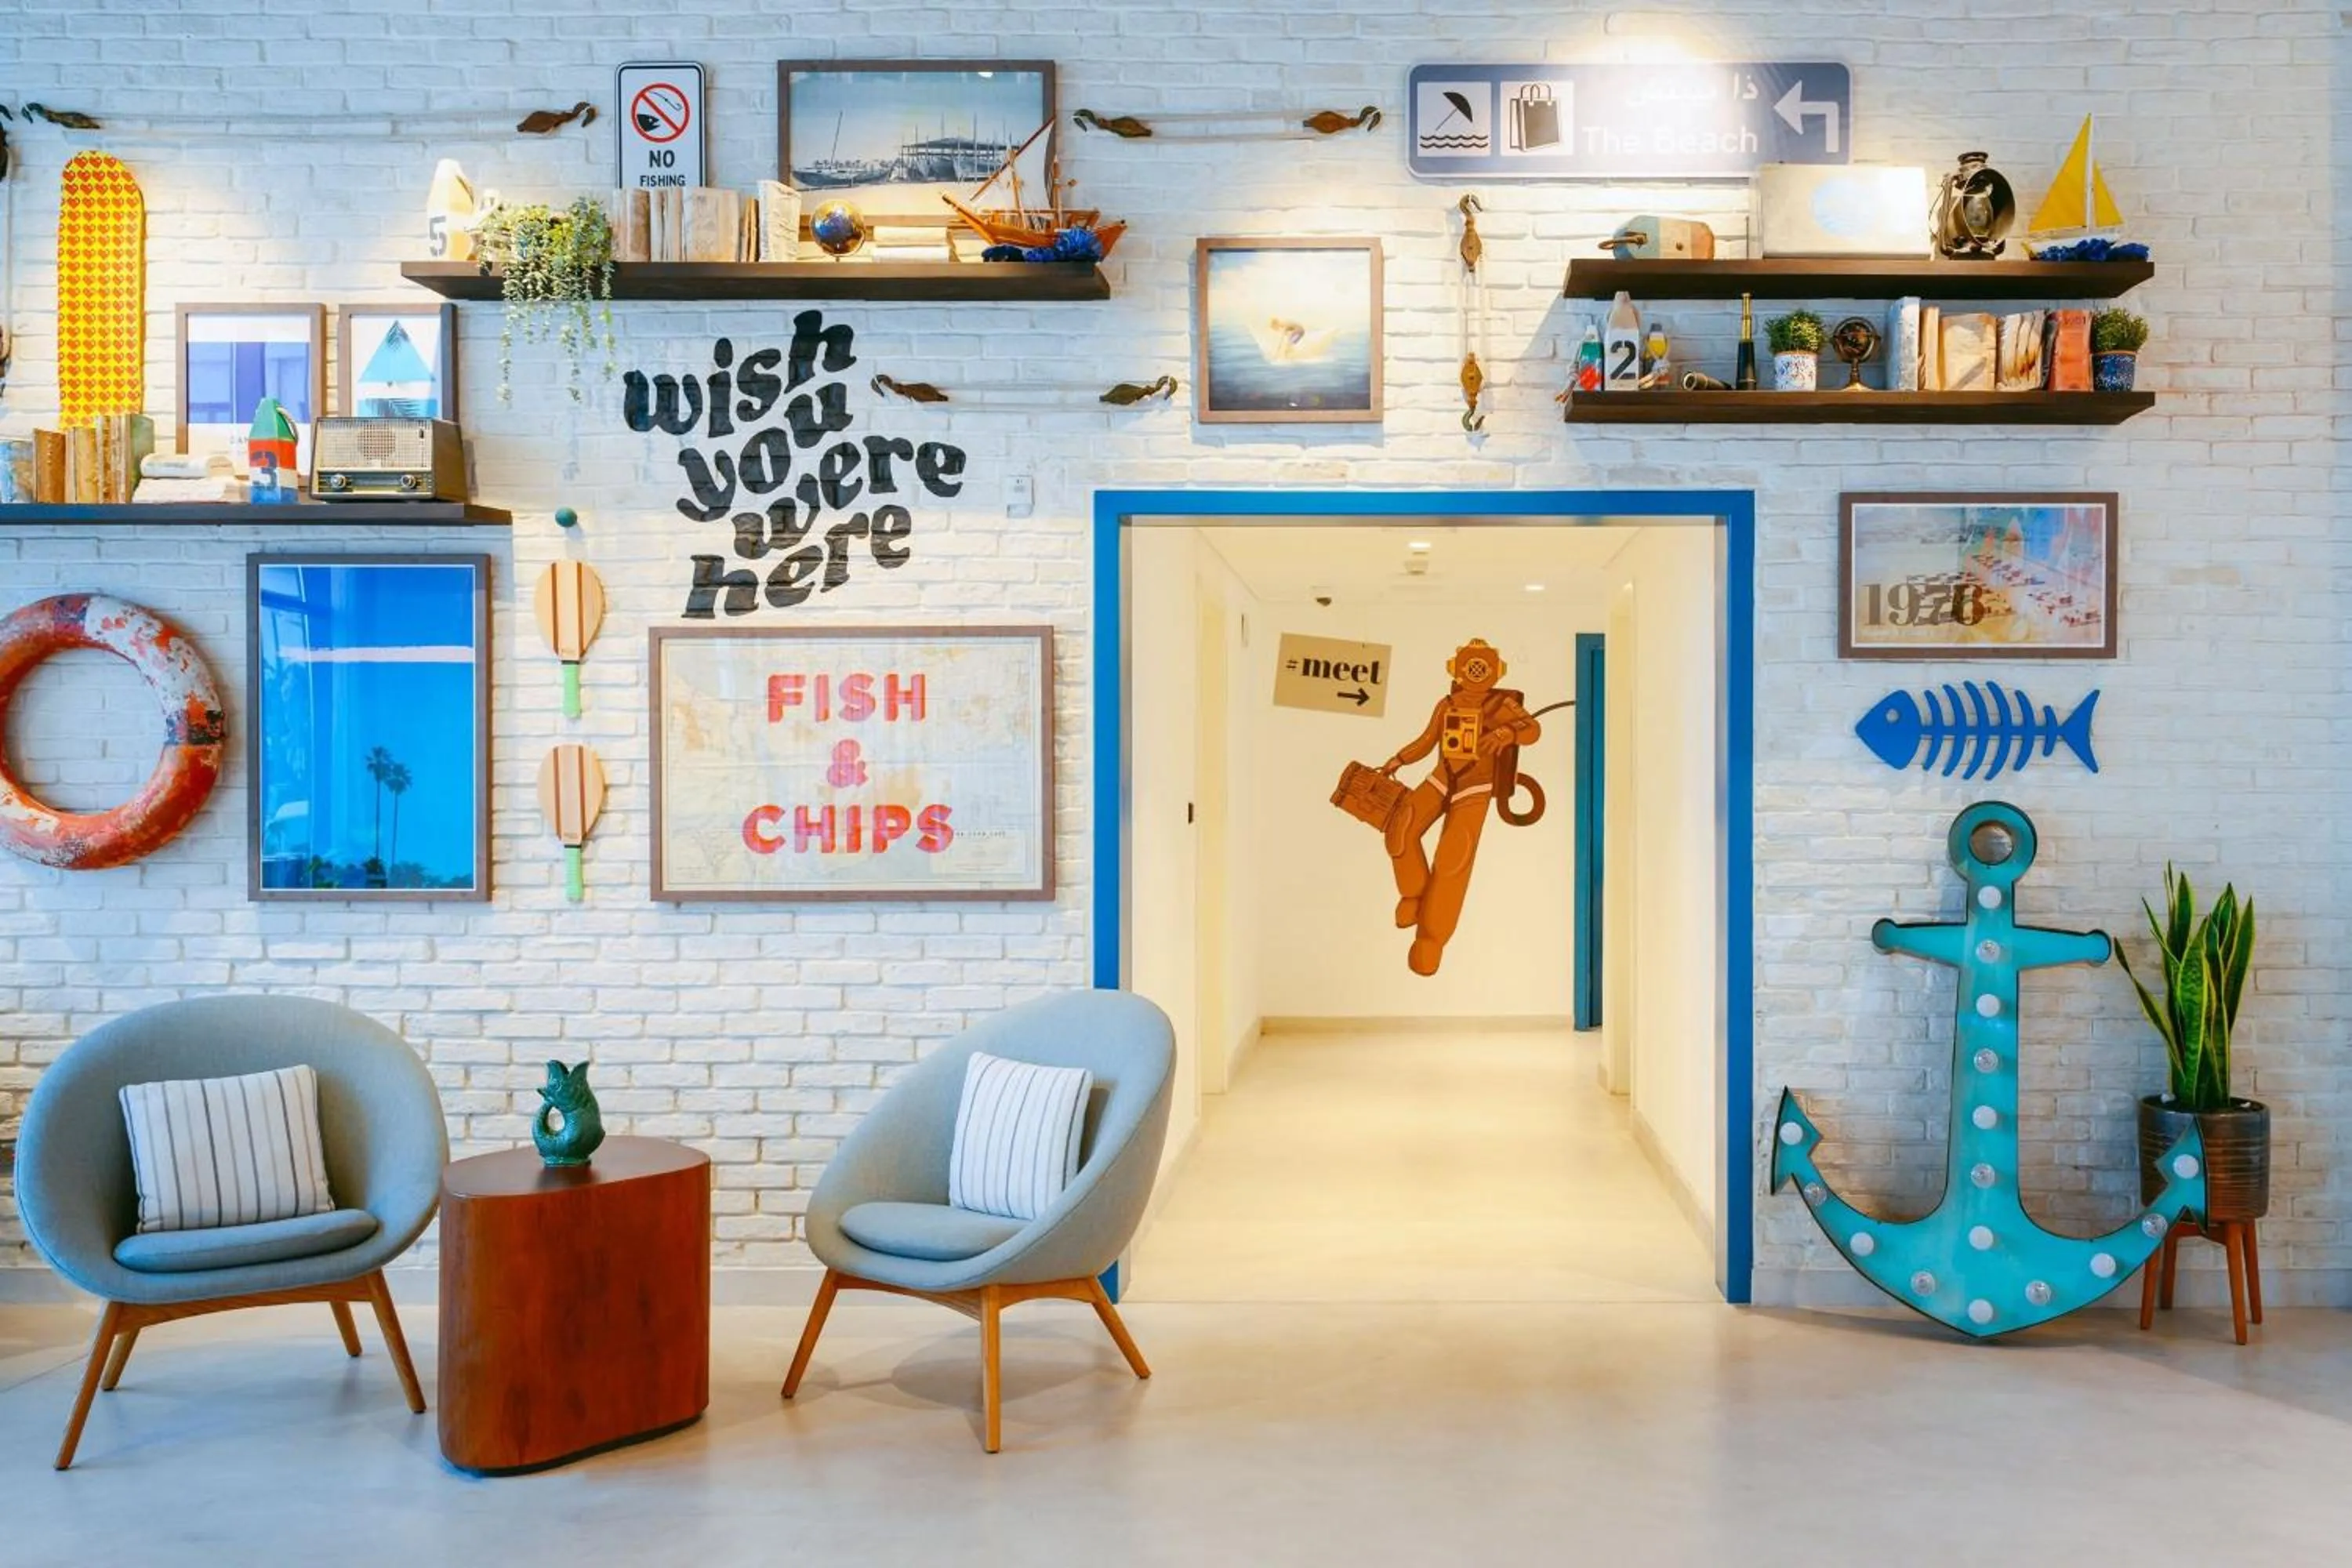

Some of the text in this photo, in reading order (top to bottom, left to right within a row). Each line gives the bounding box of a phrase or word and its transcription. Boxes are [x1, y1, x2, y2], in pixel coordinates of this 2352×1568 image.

[648, 150, 675, 168] NO
[1581, 124, 1759, 154] The Beach
[639, 175, 686, 187] FISHING
[429, 215, 447, 257] 5
[622, 310, 857, 438] wish
[1610, 339, 1636, 380] 2
[250, 450, 278, 492] 3
[675, 382, 854, 523] you
[731, 434, 967, 560] were
[680, 503, 912, 619] here
[767, 672, 927, 723] FISH
[826, 739, 869, 789] &
[741, 802, 956, 855] CHIPS
